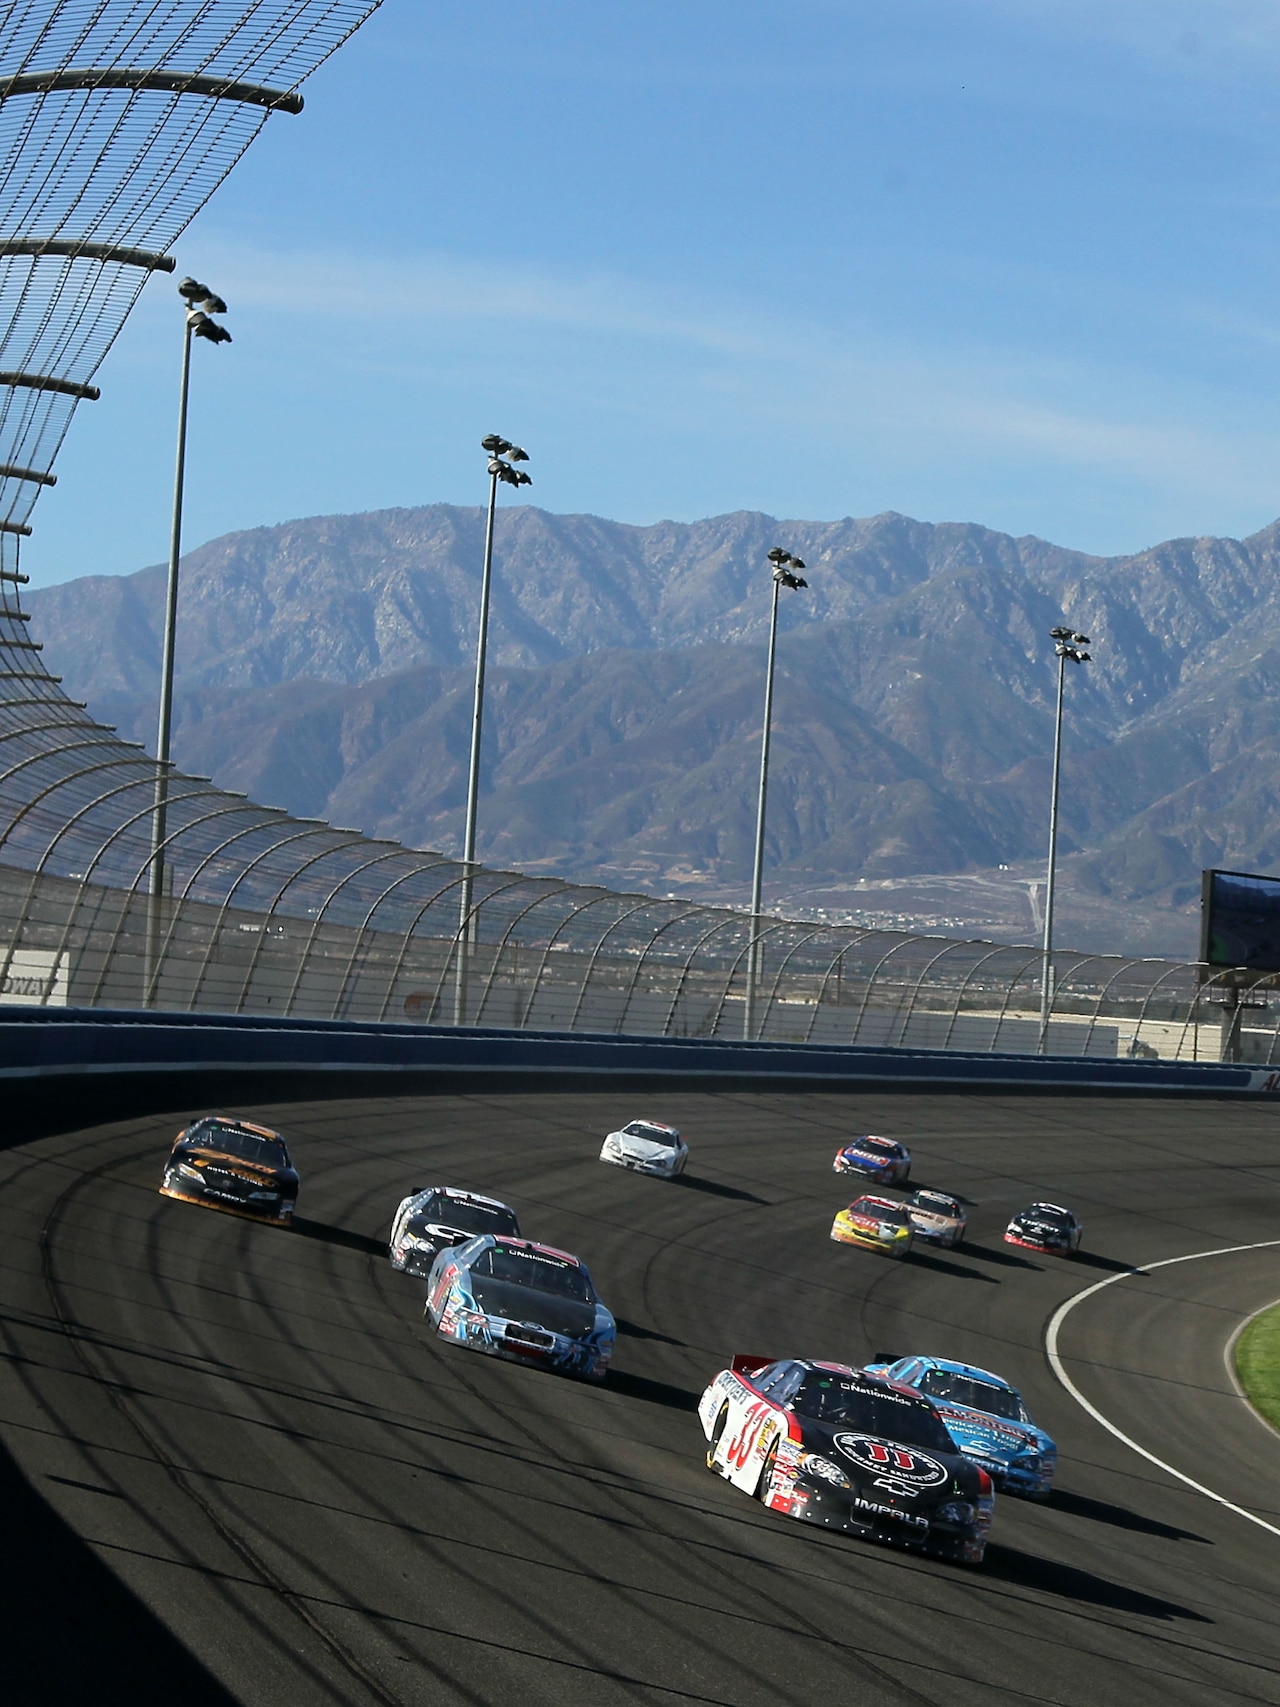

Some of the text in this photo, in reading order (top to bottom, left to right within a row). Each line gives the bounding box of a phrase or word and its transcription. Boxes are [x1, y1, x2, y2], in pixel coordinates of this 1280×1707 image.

[516, 1251, 566, 1269] Nationwide
[851, 1382, 912, 1407] Nationwide
[854, 1497, 930, 1529] IMPALA
